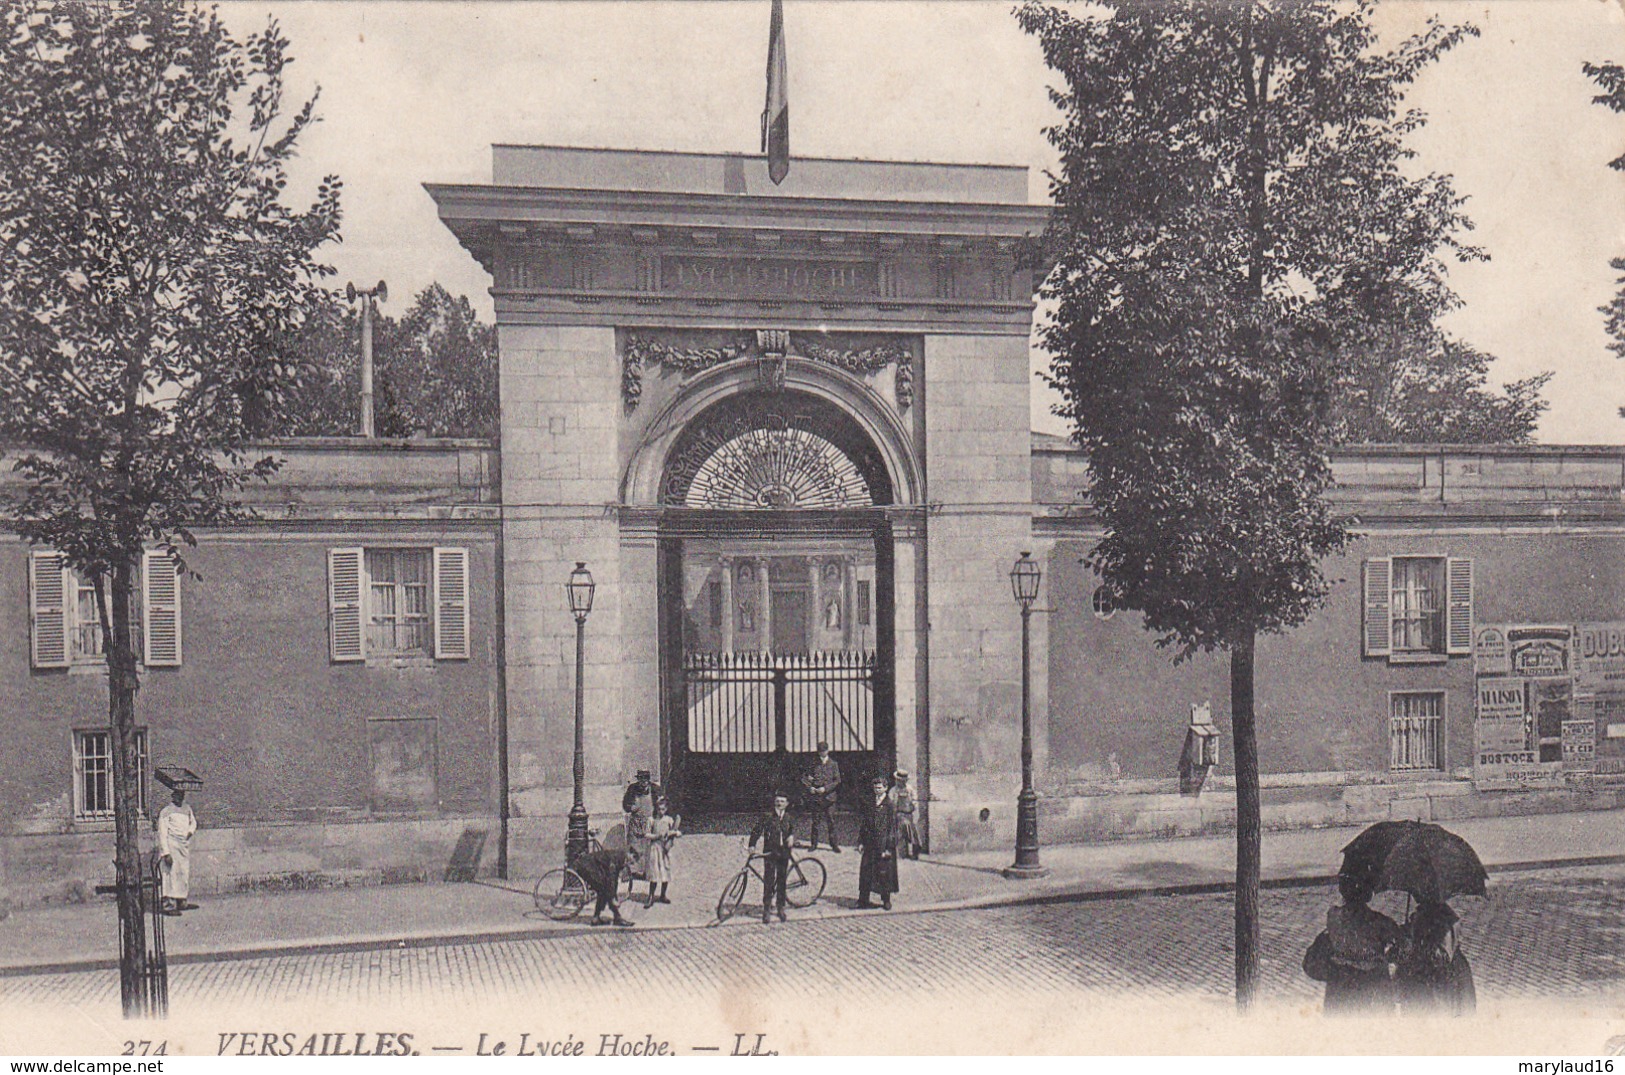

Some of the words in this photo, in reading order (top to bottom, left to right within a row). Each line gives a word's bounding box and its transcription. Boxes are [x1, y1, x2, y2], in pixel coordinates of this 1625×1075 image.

[1583, 629, 1625, 658] DUB
[1480, 688, 1522, 705] MAISON
[1480, 752, 1535, 765] BOSTOCK
